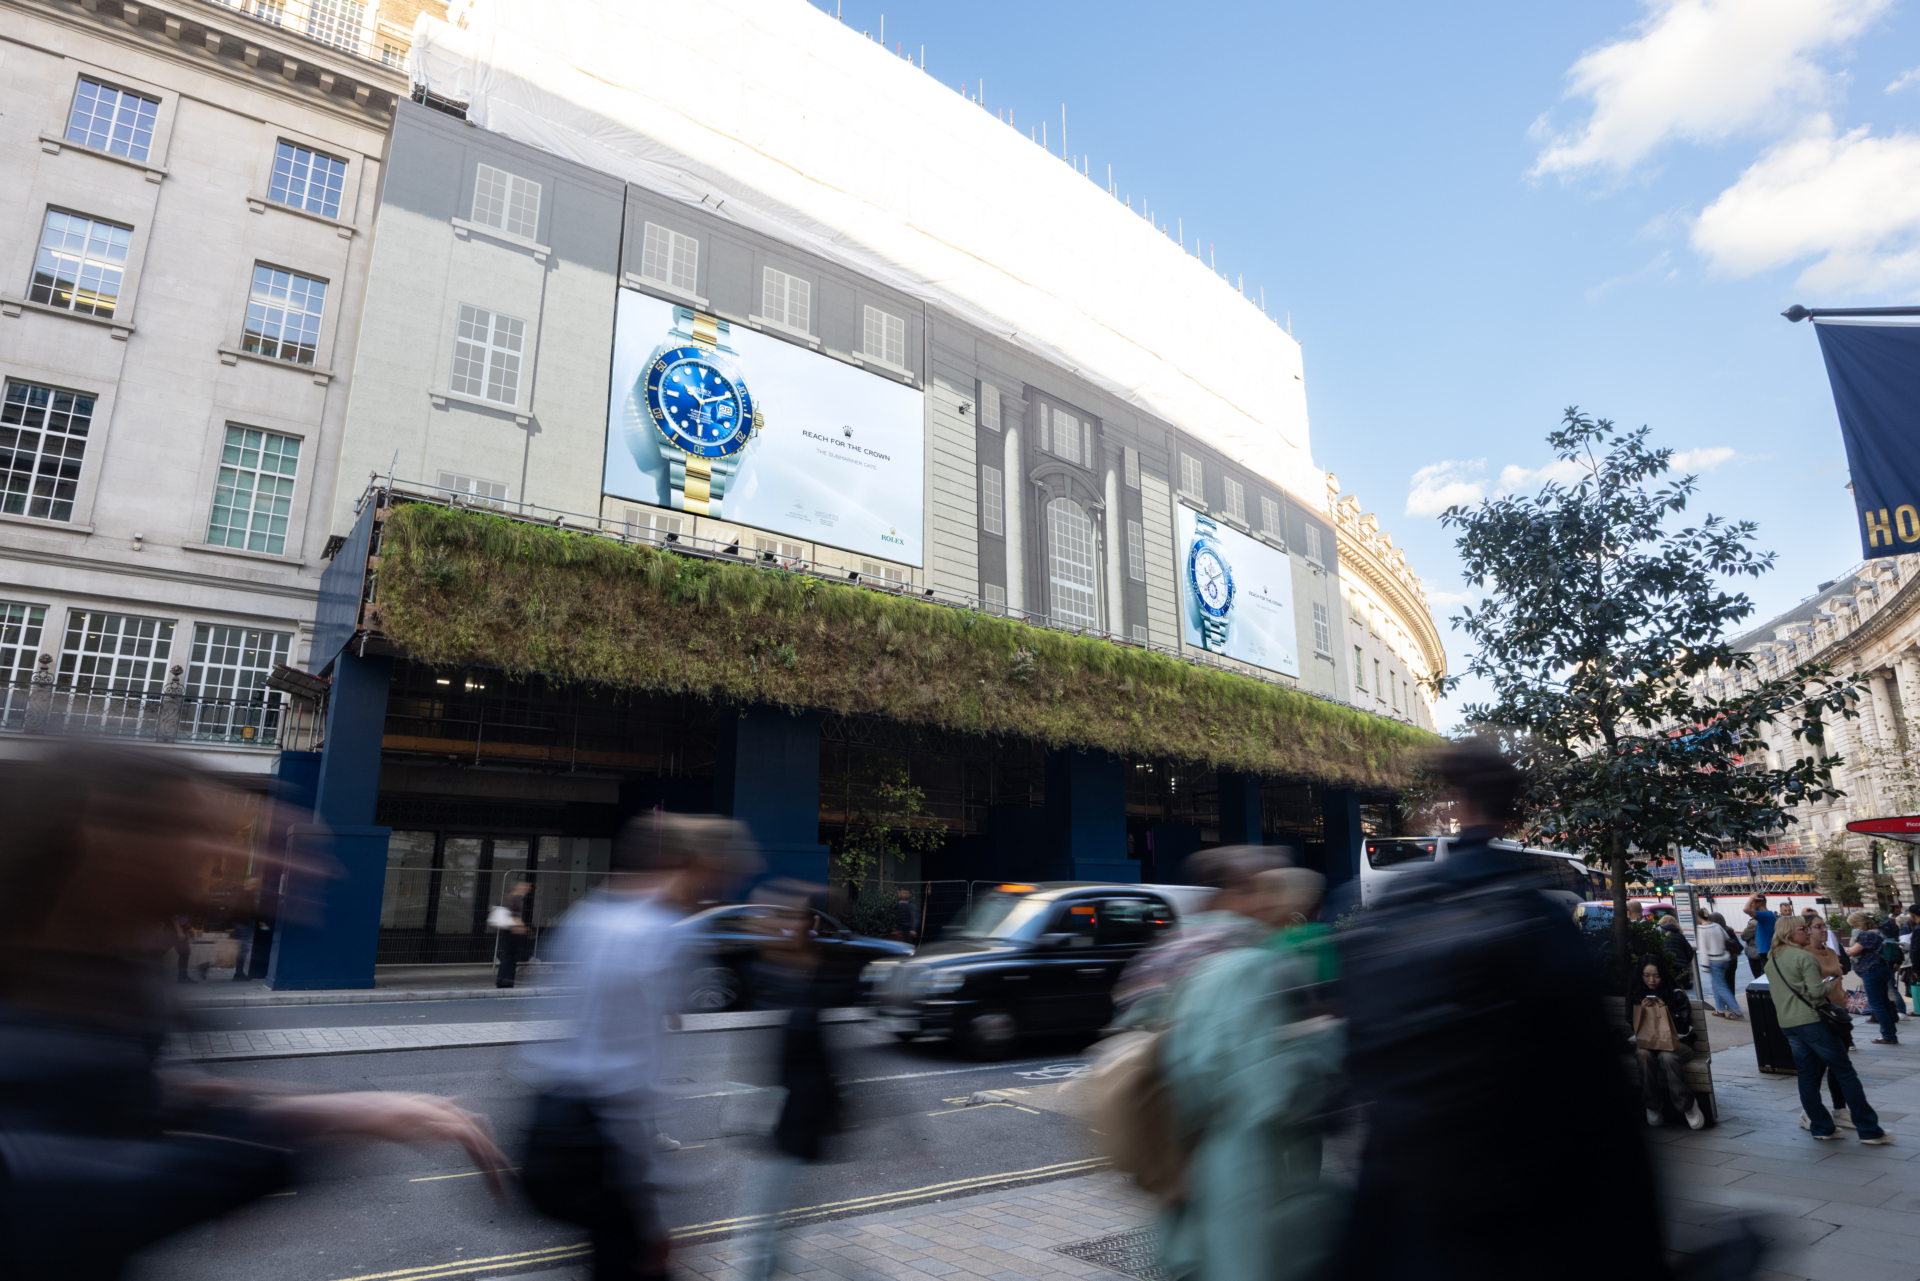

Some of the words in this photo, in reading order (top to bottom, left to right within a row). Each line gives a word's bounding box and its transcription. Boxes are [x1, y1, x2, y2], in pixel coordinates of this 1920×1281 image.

[655, 359, 668, 373] 50
[652, 407, 664, 419] 40
[719, 405, 732, 415] 28
[735, 430, 746, 443] 20
[693, 444, 705, 455] 30
[802, 429, 829, 443] REACH
[830, 438, 846, 448] FOR
[847, 443, 862, 453] THE
[863, 448, 891, 462] CROWN
[816, 448, 827, 456] THE
[828, 451, 863, 467] SUBMARINER
[863, 462, 877, 471] DATE
[1865, 504, 1920, 548] HO
[881, 534, 905, 546] ROLEX
